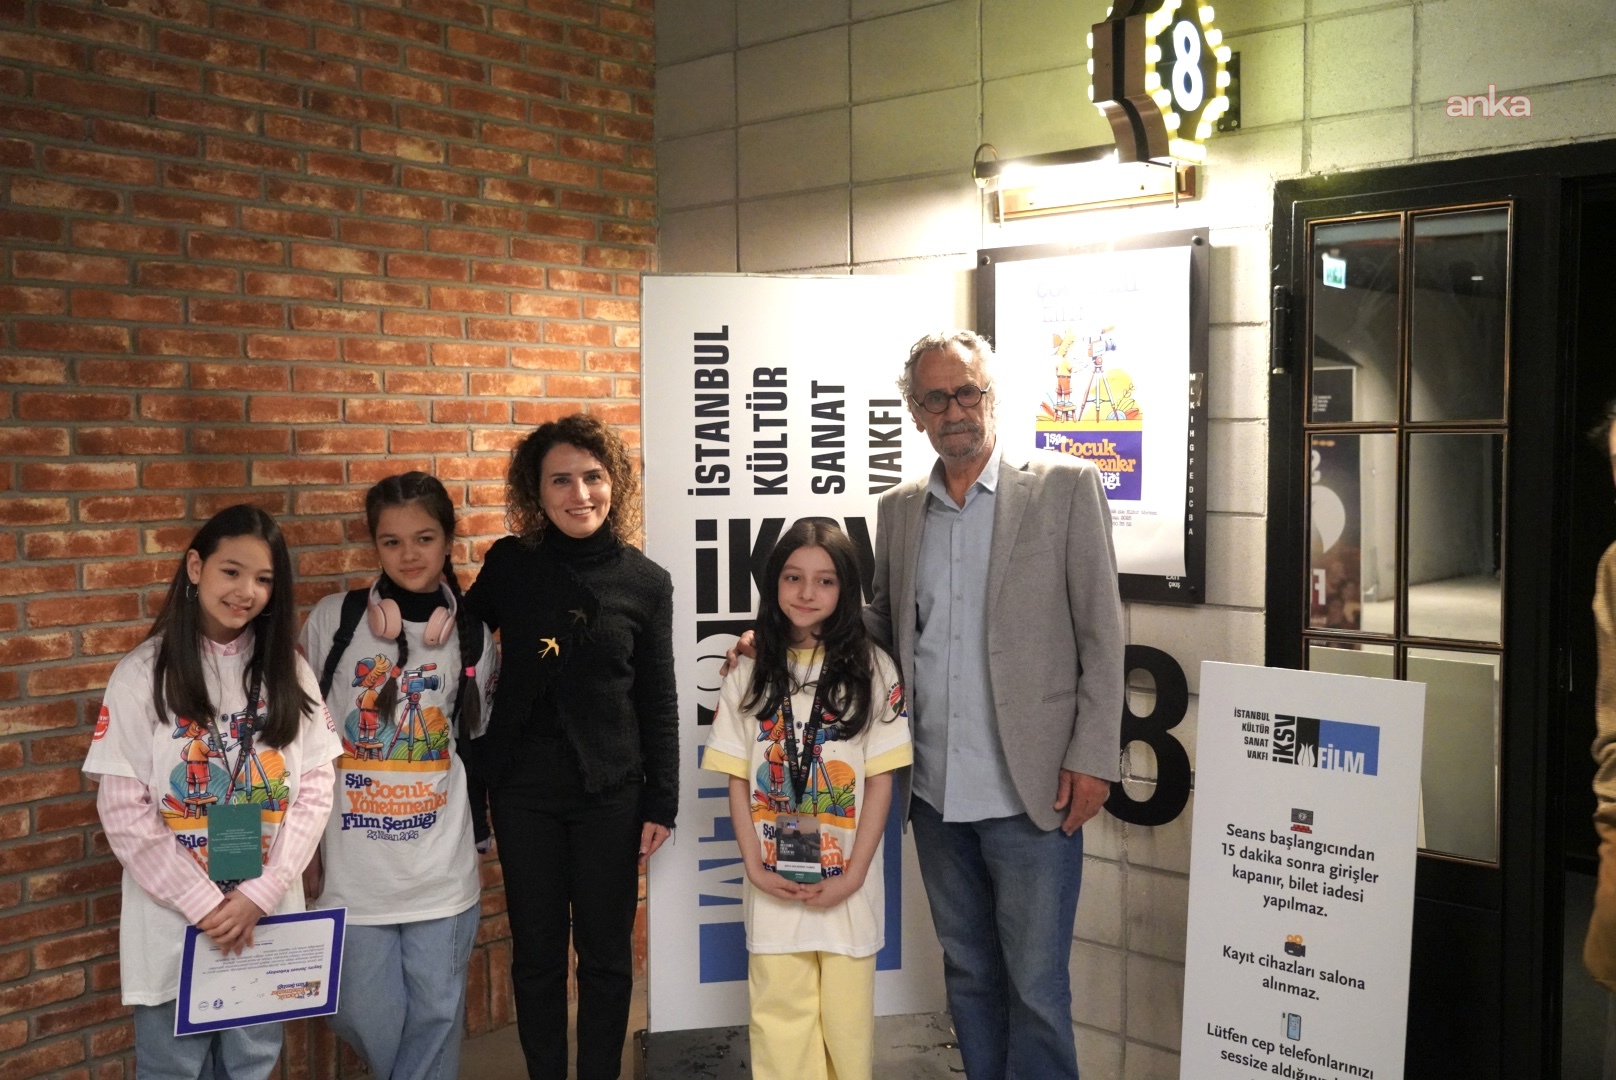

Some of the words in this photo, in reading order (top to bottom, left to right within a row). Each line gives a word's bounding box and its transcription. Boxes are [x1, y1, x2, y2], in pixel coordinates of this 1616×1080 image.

[1172, 20, 1203, 111] 8
[688, 325, 730, 496] İSTANBUL
[746, 367, 788, 495] KÜLTÜR
[811, 380, 845, 494] SANAT
[869, 399, 902, 495] VAKFI
[1234, 707, 1270, 721] İSTANBUL
[1242, 722, 1269, 734] KÜLTÜR
[1102, 645, 1191, 826] 8
[1244, 736, 1269, 747] SANAT
[1247, 750, 1268, 761] VAKFI
[1318, 744, 1365, 774] FİLM
[345, 773, 372, 789] Şile
[366, 779, 435, 800] Çocuk
[341, 813, 381, 830] Film
[383, 811, 437, 832] Şenliği
[367, 829, 378, 840] 23
[400, 830, 418, 841] 2025
[1226, 823, 1265, 841] Seans
[1270, 830, 1374, 861] başlangıcından
[1221, 843, 1235, 856] 15
[1240, 846, 1282, 865] dakika
[1286, 857, 1325, 874] sonra
[1329, 864, 1379, 883] girişler
[1232, 864, 1284, 889] kapanır,
[1289, 875, 1318, 894] bilet
[1323, 882, 1364, 902] iadesi
[1263, 894, 1328, 917] yapılmaz.
[1223, 945, 1255, 964] Kayıt
[1258, 954, 1315, 978] cihazları
[1319, 970, 1365, 990] salona
[1262, 976, 1320, 1001] alınmaz.
[1207, 1023, 1247, 1045] Lütfen
[1251, 1038, 1275, 1055] cep
[1279, 1043, 1374, 1080] telefonlarınızı
[1221, 1050, 1268, 1071] sessize
